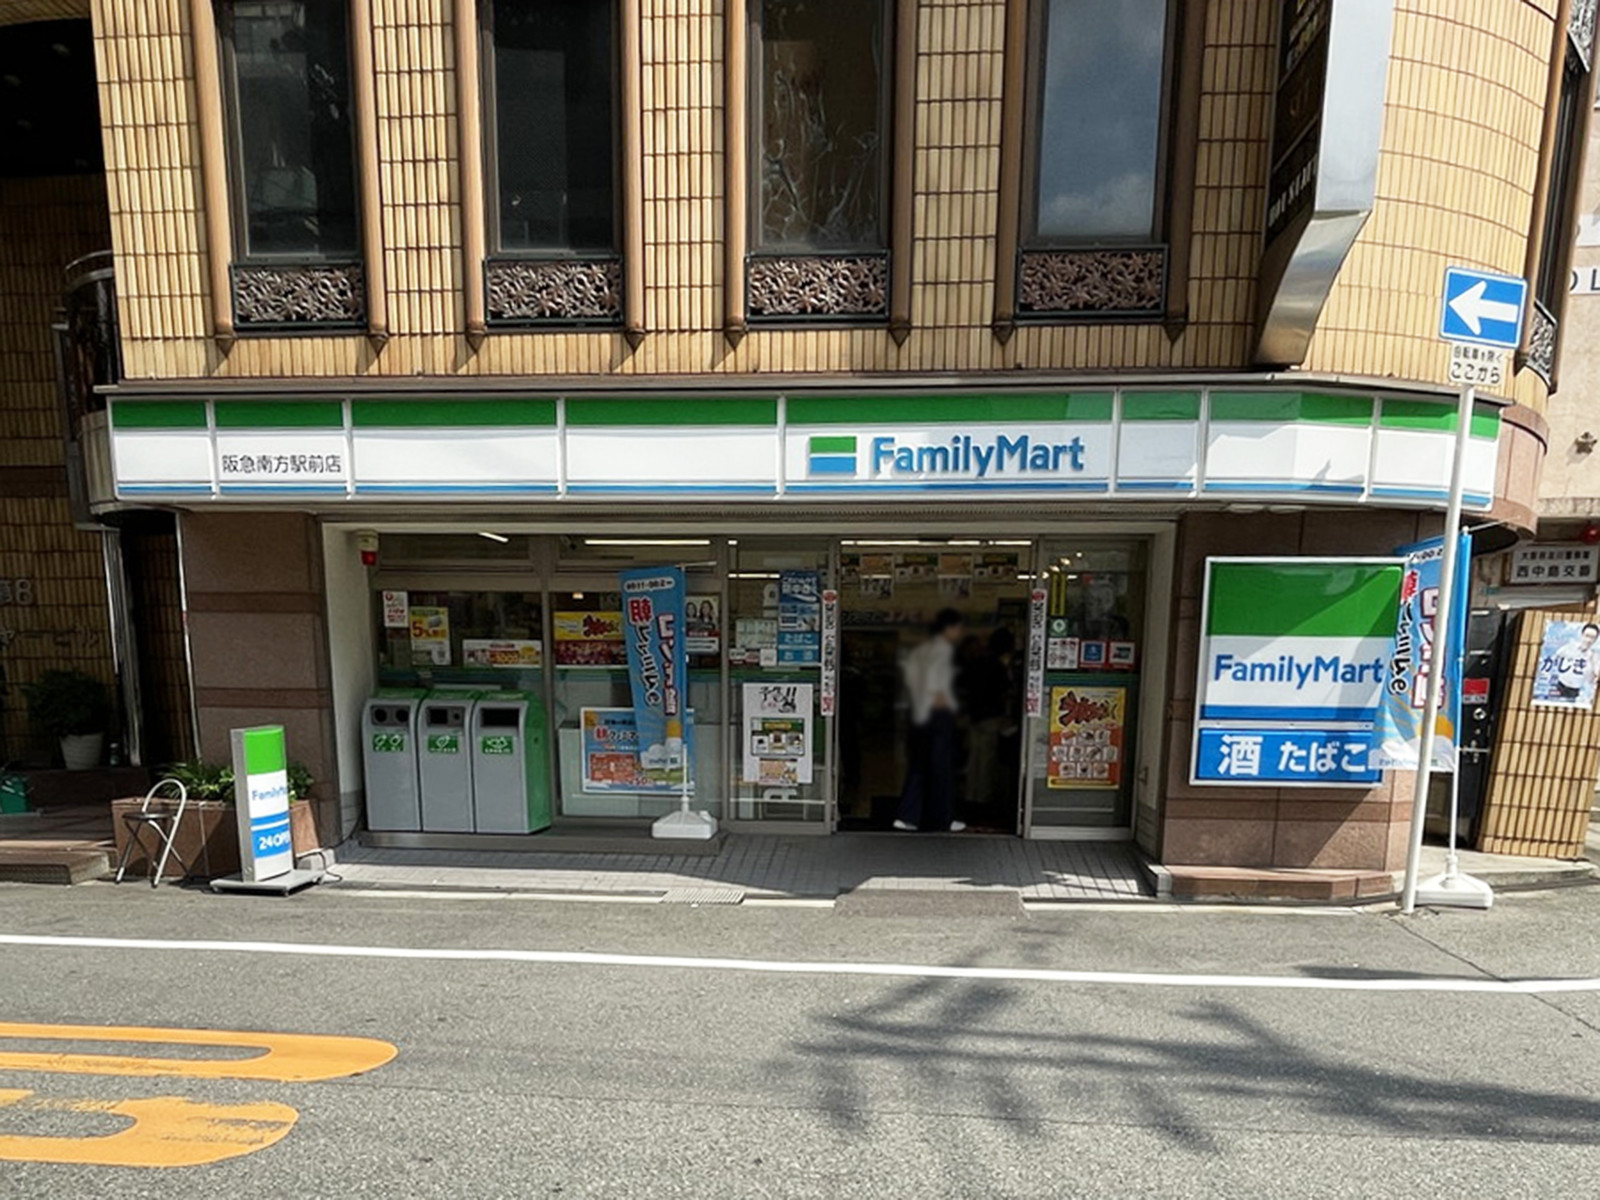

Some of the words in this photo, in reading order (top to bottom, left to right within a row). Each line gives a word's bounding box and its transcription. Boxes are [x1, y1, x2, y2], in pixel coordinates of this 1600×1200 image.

[1451, 361, 1500, 384] ここから
[222, 453, 342, 474] 阪急南方駅前店
[871, 434, 1085, 477] FamilyMart
[1516, 564, 1591, 578] 西中島交番
[1213, 654, 1383, 690] FamilyMart
[1217, 734, 1263, 776] 酒
[1278, 740, 1368, 774] たばこ
